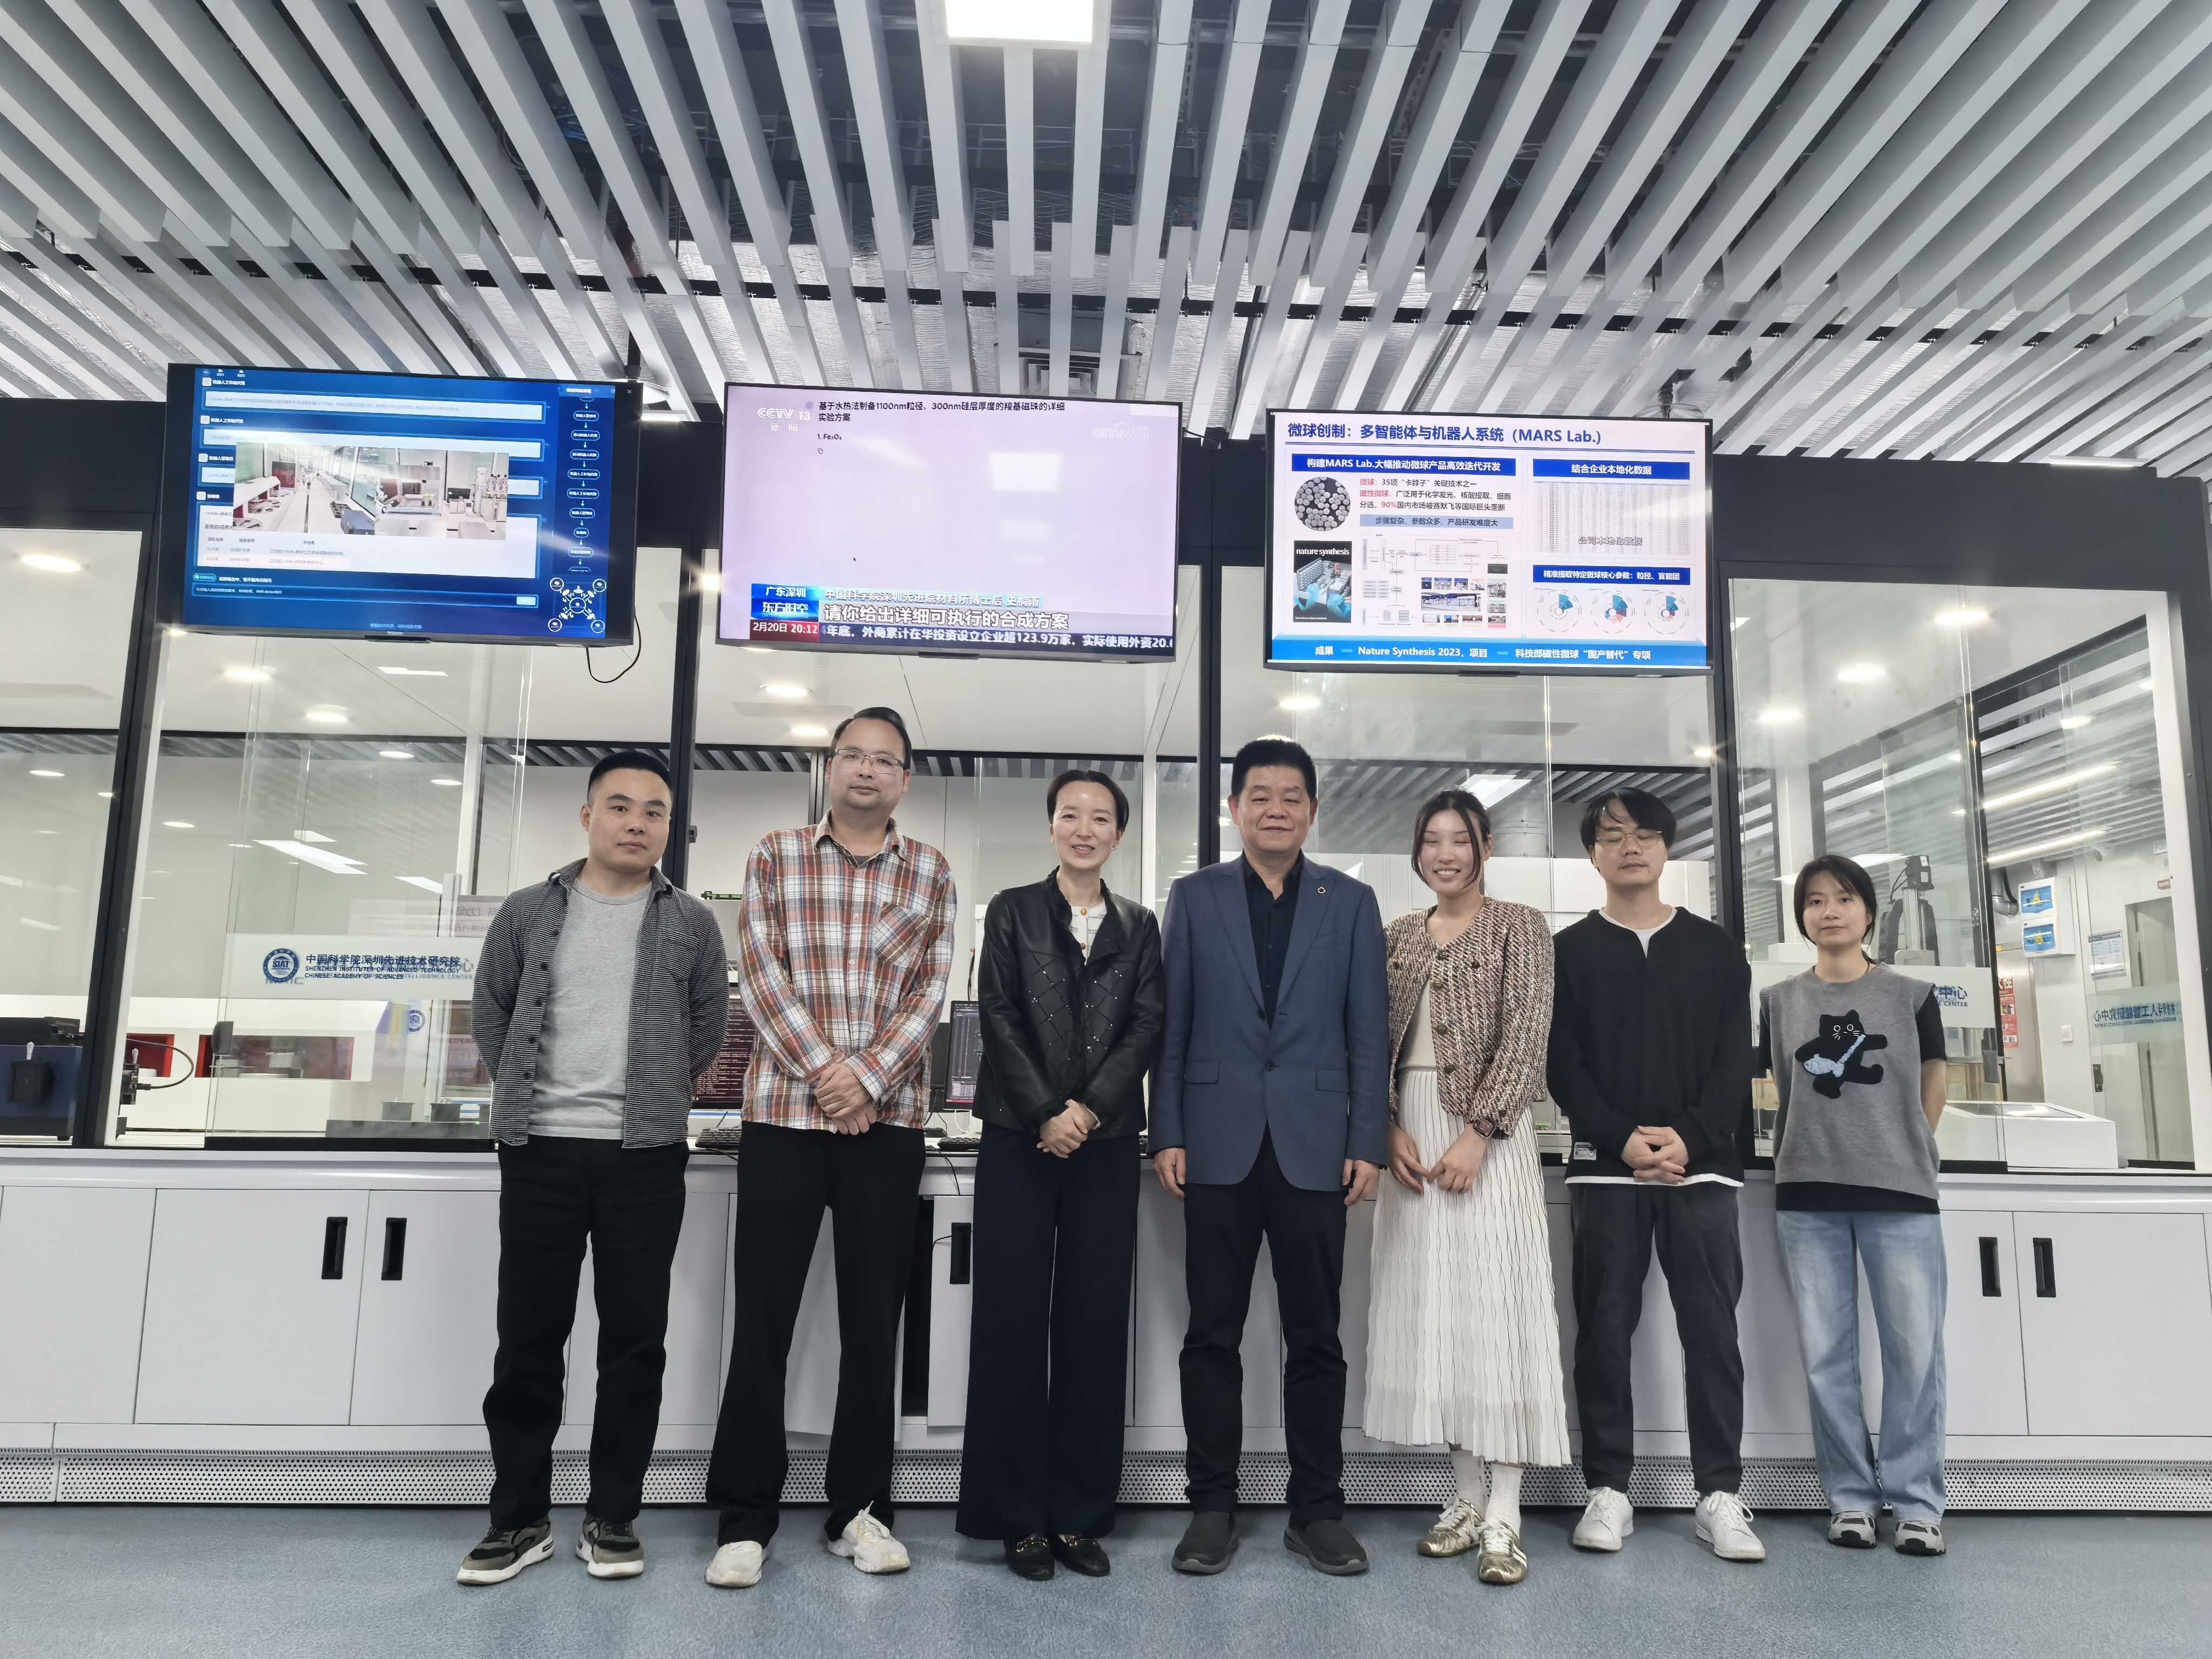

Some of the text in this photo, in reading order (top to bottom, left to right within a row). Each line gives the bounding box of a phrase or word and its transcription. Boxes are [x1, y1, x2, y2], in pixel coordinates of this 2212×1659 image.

[757, 408, 811, 421] CCTV 13
[818, 413, 851, 422] 实验方案
[1307, 458, 1353, 468] 构建MARS
[1571, 464, 1652, 475] 结合企业本地化数据
[765, 586, 806, 598] 广东深圳
[762, 602, 809, 615] 东方时空
[824, 604, 1069, 630] 请你给出详细可执行的合成方案
[753, 622, 818, 634] 2月20日 20:12
[1315, 646, 1334, 655] 成果
[1358, 646, 1390, 656] Nature
[1392, 647, 1435, 657] Synthesis
[306, 954, 461, 967] 中国科学院深圳先进技术研究院
